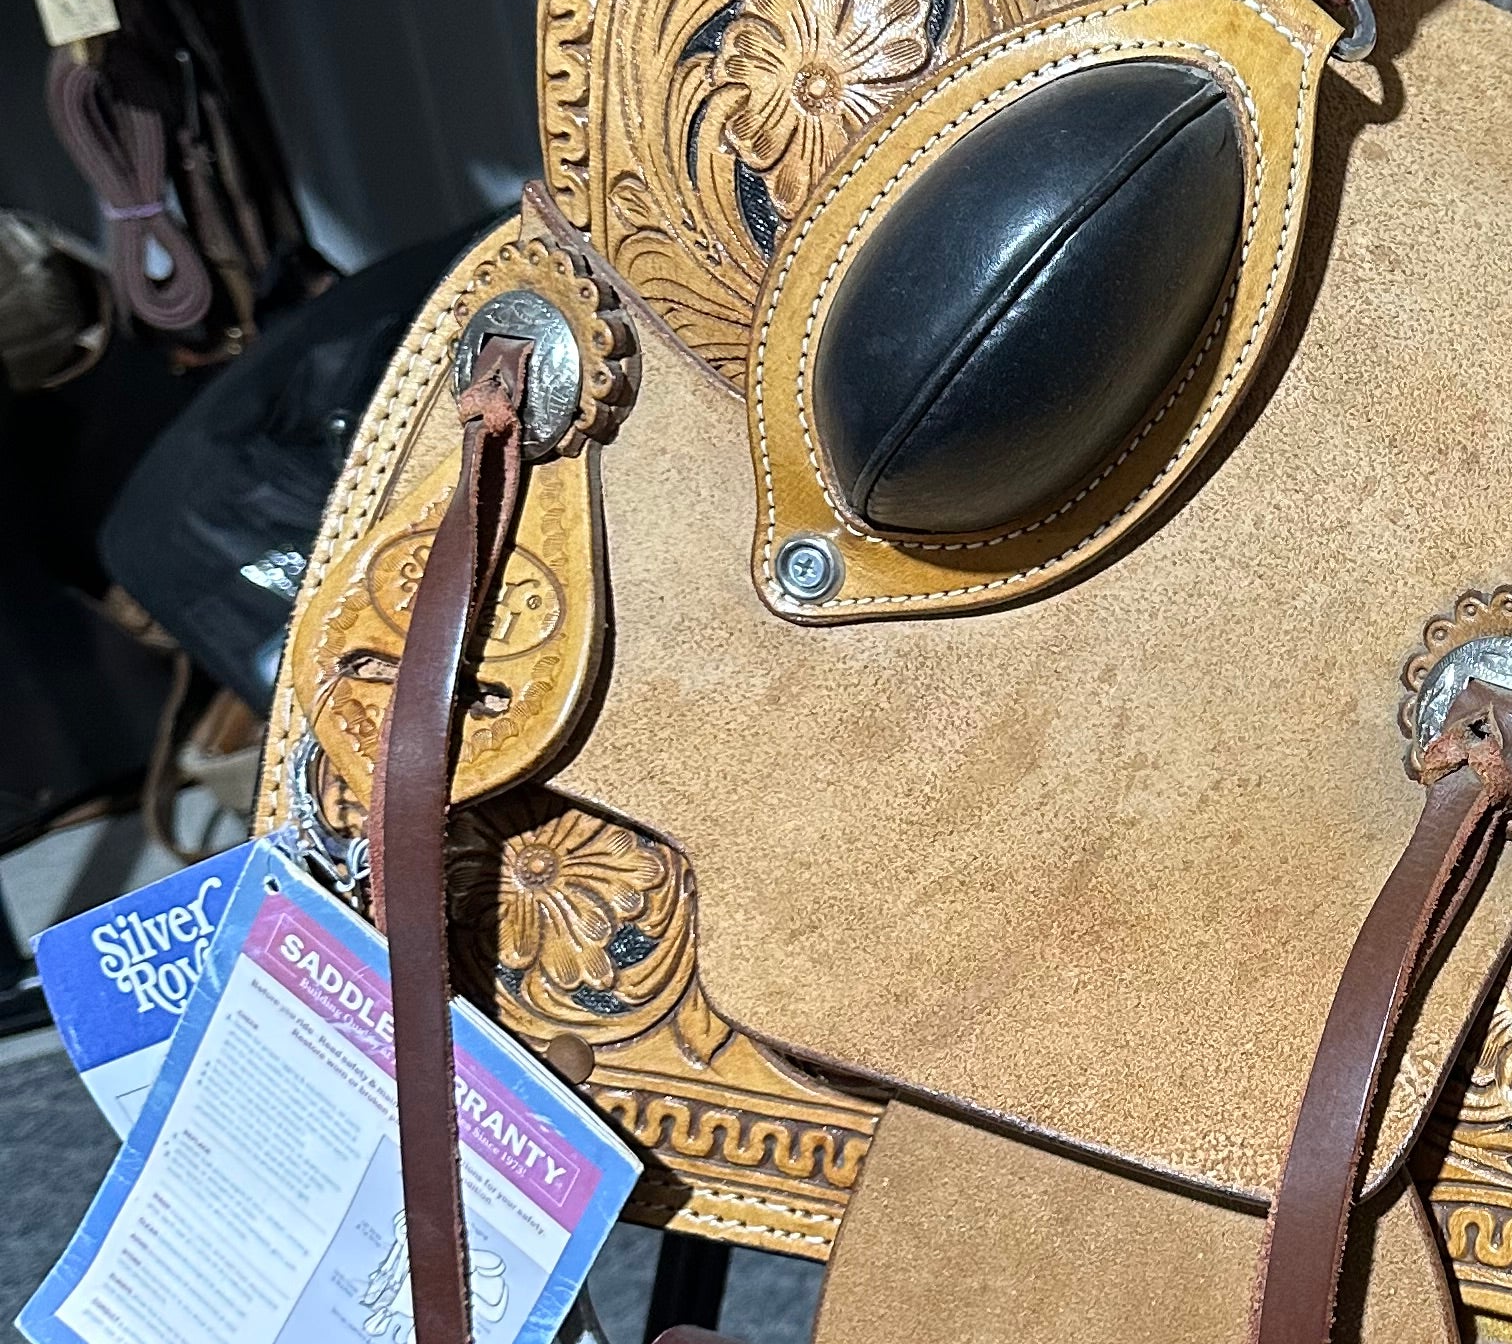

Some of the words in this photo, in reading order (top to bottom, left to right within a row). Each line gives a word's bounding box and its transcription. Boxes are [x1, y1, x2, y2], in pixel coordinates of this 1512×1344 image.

[91, 877, 222, 978] Silver
[280, 934, 395, 1043] SADDLE
[454, 1074, 567, 1185] RRANTY
[299, 977, 342, 1019] Building
[472, 1127, 501, 1156] Since
[501, 1151, 528, 1178] 1973!
[484, 1175, 498, 1193] for
[497, 1190, 517, 1211] your
